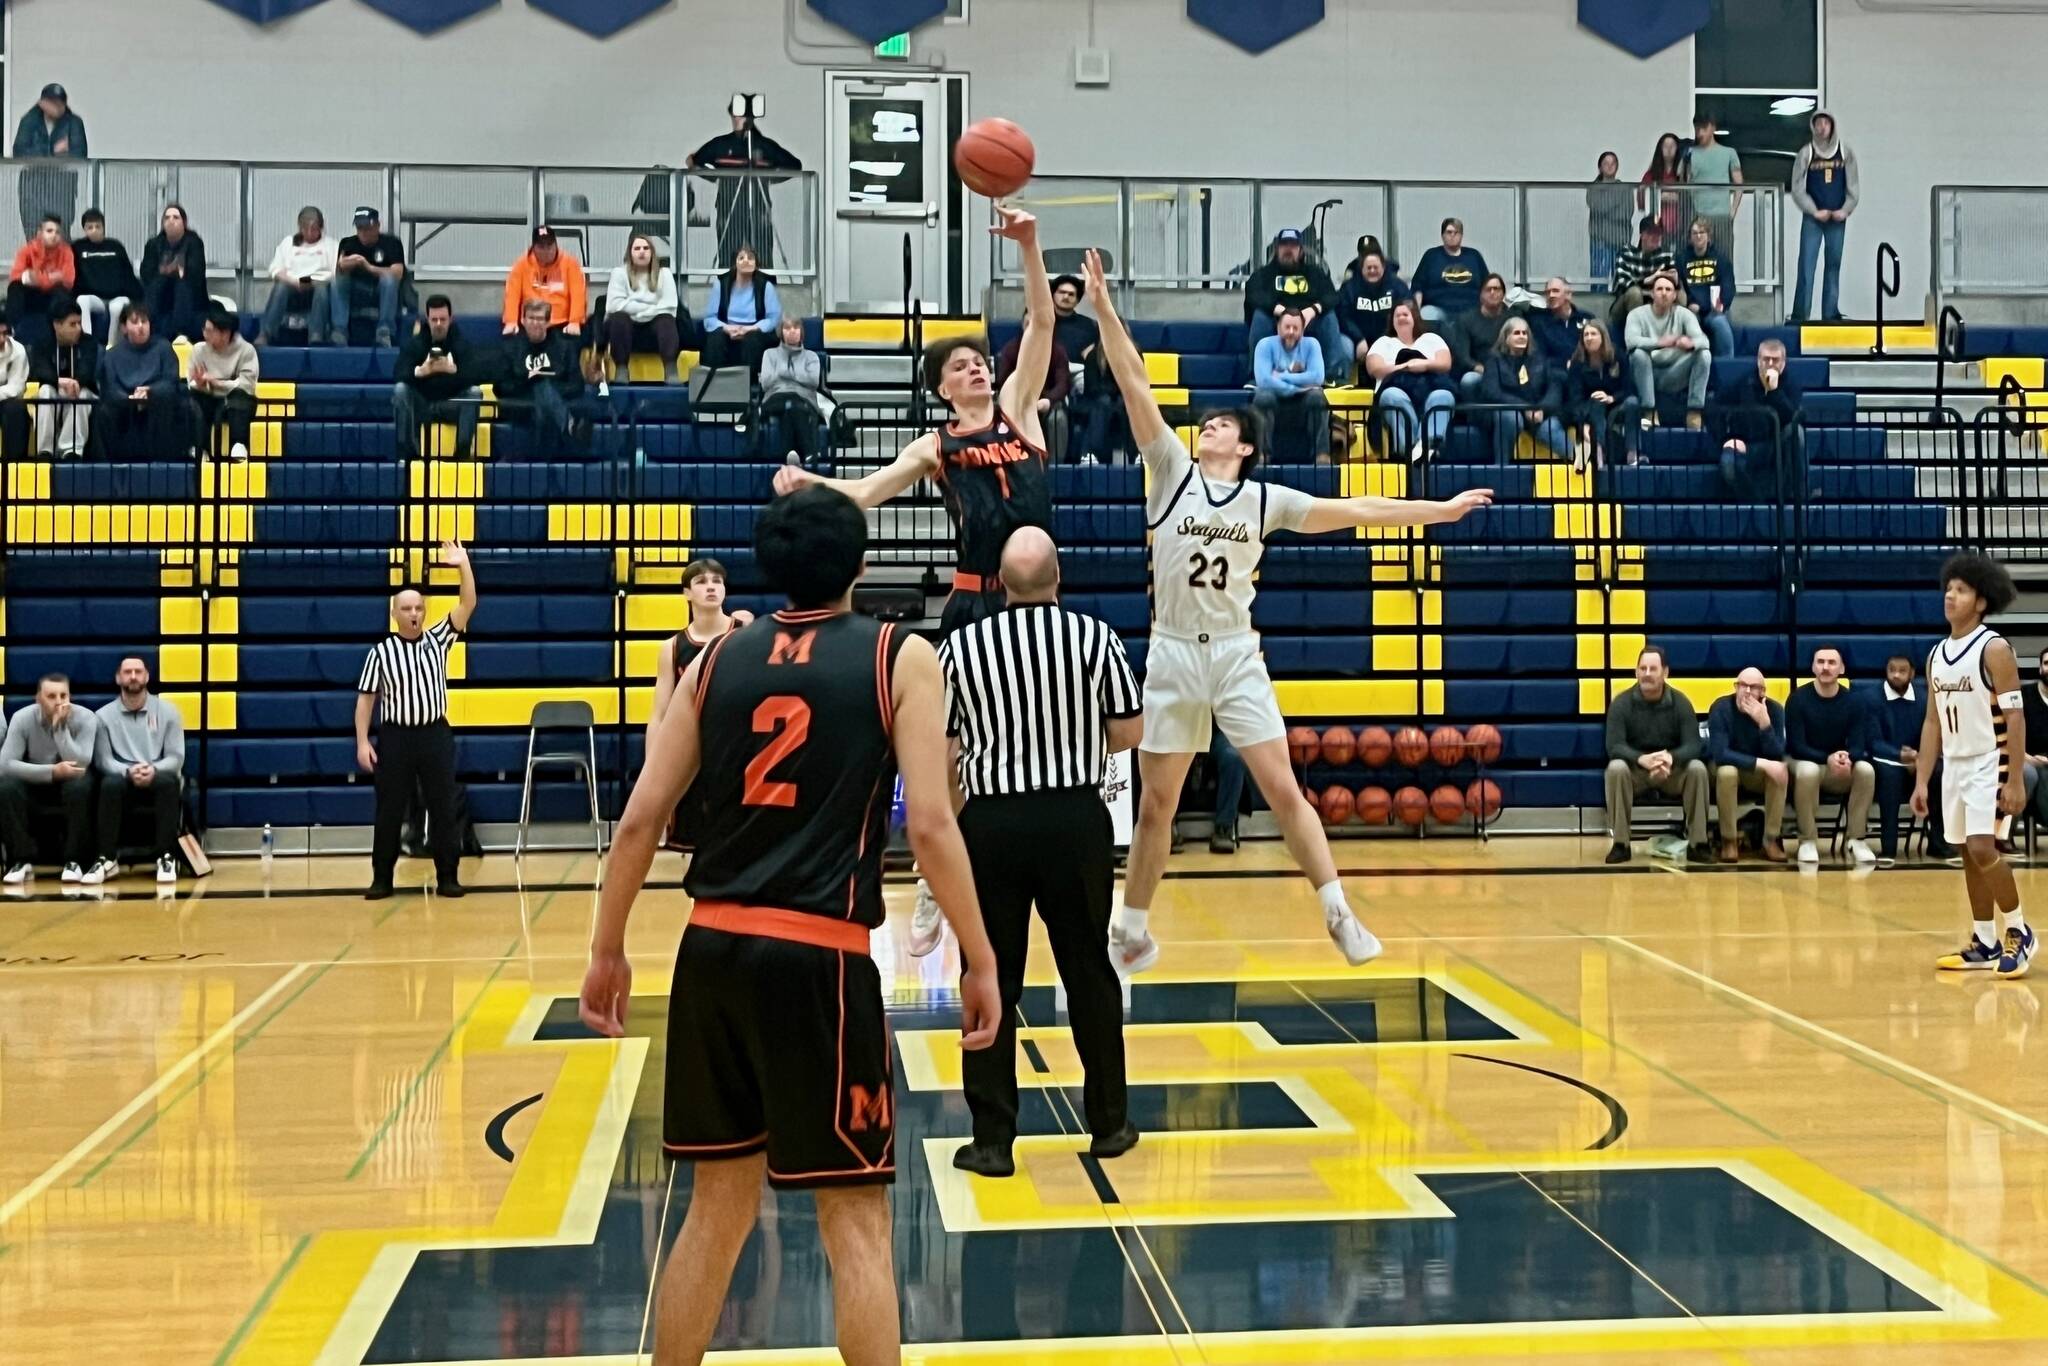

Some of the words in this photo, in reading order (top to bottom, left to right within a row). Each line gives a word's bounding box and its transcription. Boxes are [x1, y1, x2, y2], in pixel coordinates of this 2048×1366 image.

[995, 466, 1010, 499] 1
[1177, 515, 1249, 546] Seagulls
[1188, 552, 1229, 591] 23
[766, 629, 818, 665] M
[1945, 704, 1959, 734] 11
[741, 695, 812, 808] 2
[849, 1082, 891, 1131] M
